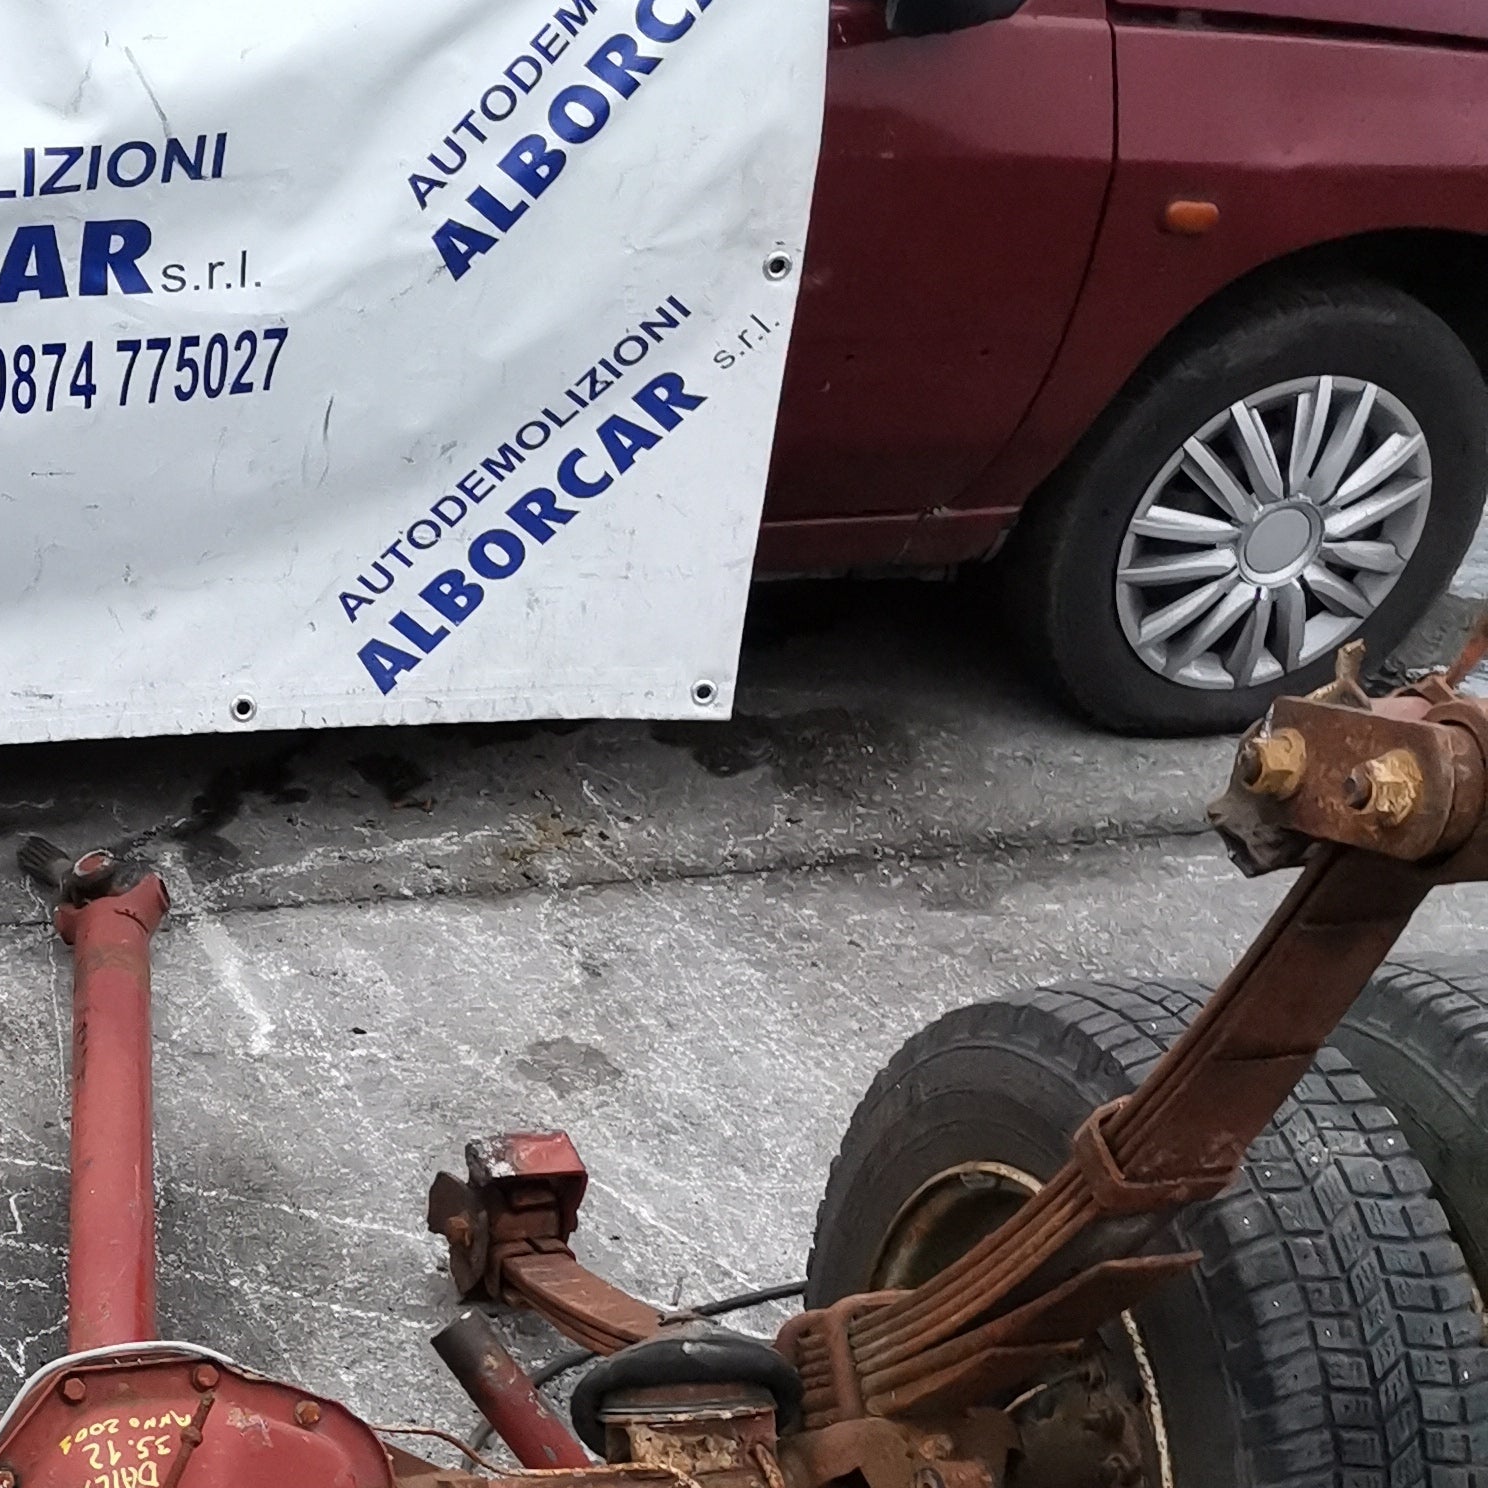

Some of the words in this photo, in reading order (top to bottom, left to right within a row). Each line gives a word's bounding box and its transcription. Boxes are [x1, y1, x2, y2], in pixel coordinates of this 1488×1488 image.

[161, 251, 262, 293] s.r.l.
[431, 0, 712, 281] ALBORC
[117, 328, 290, 408] 775027
[338, 296, 692, 623] AUTODEMOLIZIONI
[357, 372, 708, 695] ALBORCAR
[712, 314, 781, 370] s.r.l.
